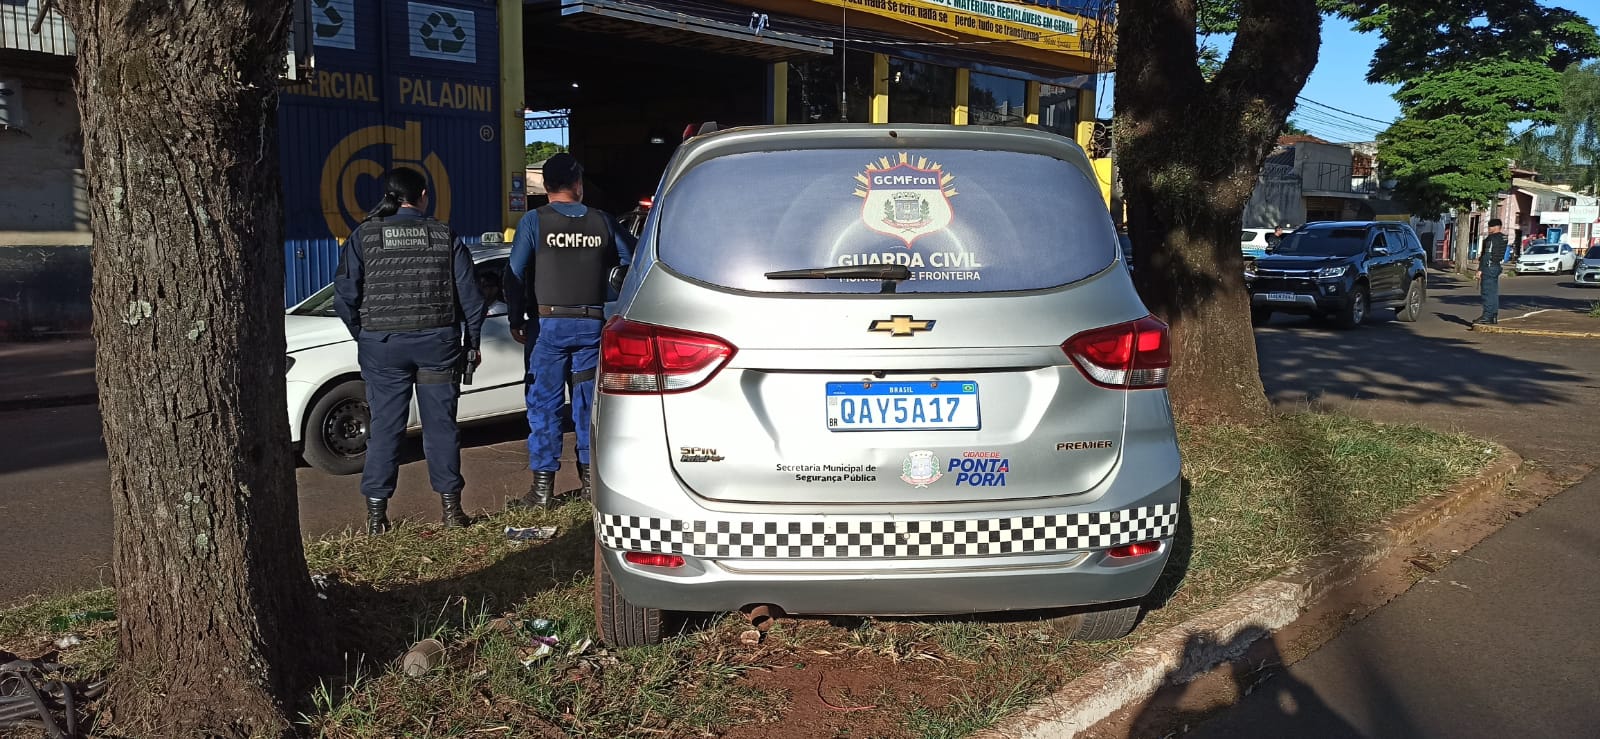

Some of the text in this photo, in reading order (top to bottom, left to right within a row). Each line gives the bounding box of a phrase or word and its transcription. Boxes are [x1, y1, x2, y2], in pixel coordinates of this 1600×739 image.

[887, 1, 898, 12] se
[918, 8, 937, 20] nada
[938, 13, 948, 23] se
[955, 16, 977, 29] perde,
[979, 20, 993, 32] tudo
[995, 25, 1003, 34] se
[954, 0, 995, 16] MATERIAIS
[996, 8, 1042, 26] RECICLÁVEIS
[1042, 18, 1054, 28] EM
[1053, 19, 1075, 34] GERAL
[281, 71, 492, 111] ERCIAL PALADINI
[874, 176, 936, 185] GCMFron
[384, 228, 426, 239] GUARDA
[384, 239, 427, 248] MUNICIPAL
[546, 233, 602, 248] GCMFron
[838, 252, 983, 268] GUARDA CIVIL
[919, 272, 981, 281] FRONTEIRA
[889, 386, 914, 394] BRASIL
[841, 398, 960, 424] QAY5A17
[829, 418, 838, 427] BR
[680, 446, 717, 455] SPIN
[1057, 441, 1113, 450] PREMIER
[776, 463, 876, 474] Secretaria Municipal de
[948, 458, 1010, 473] PONTA
[795, 473, 876, 483] Segurança Pública
